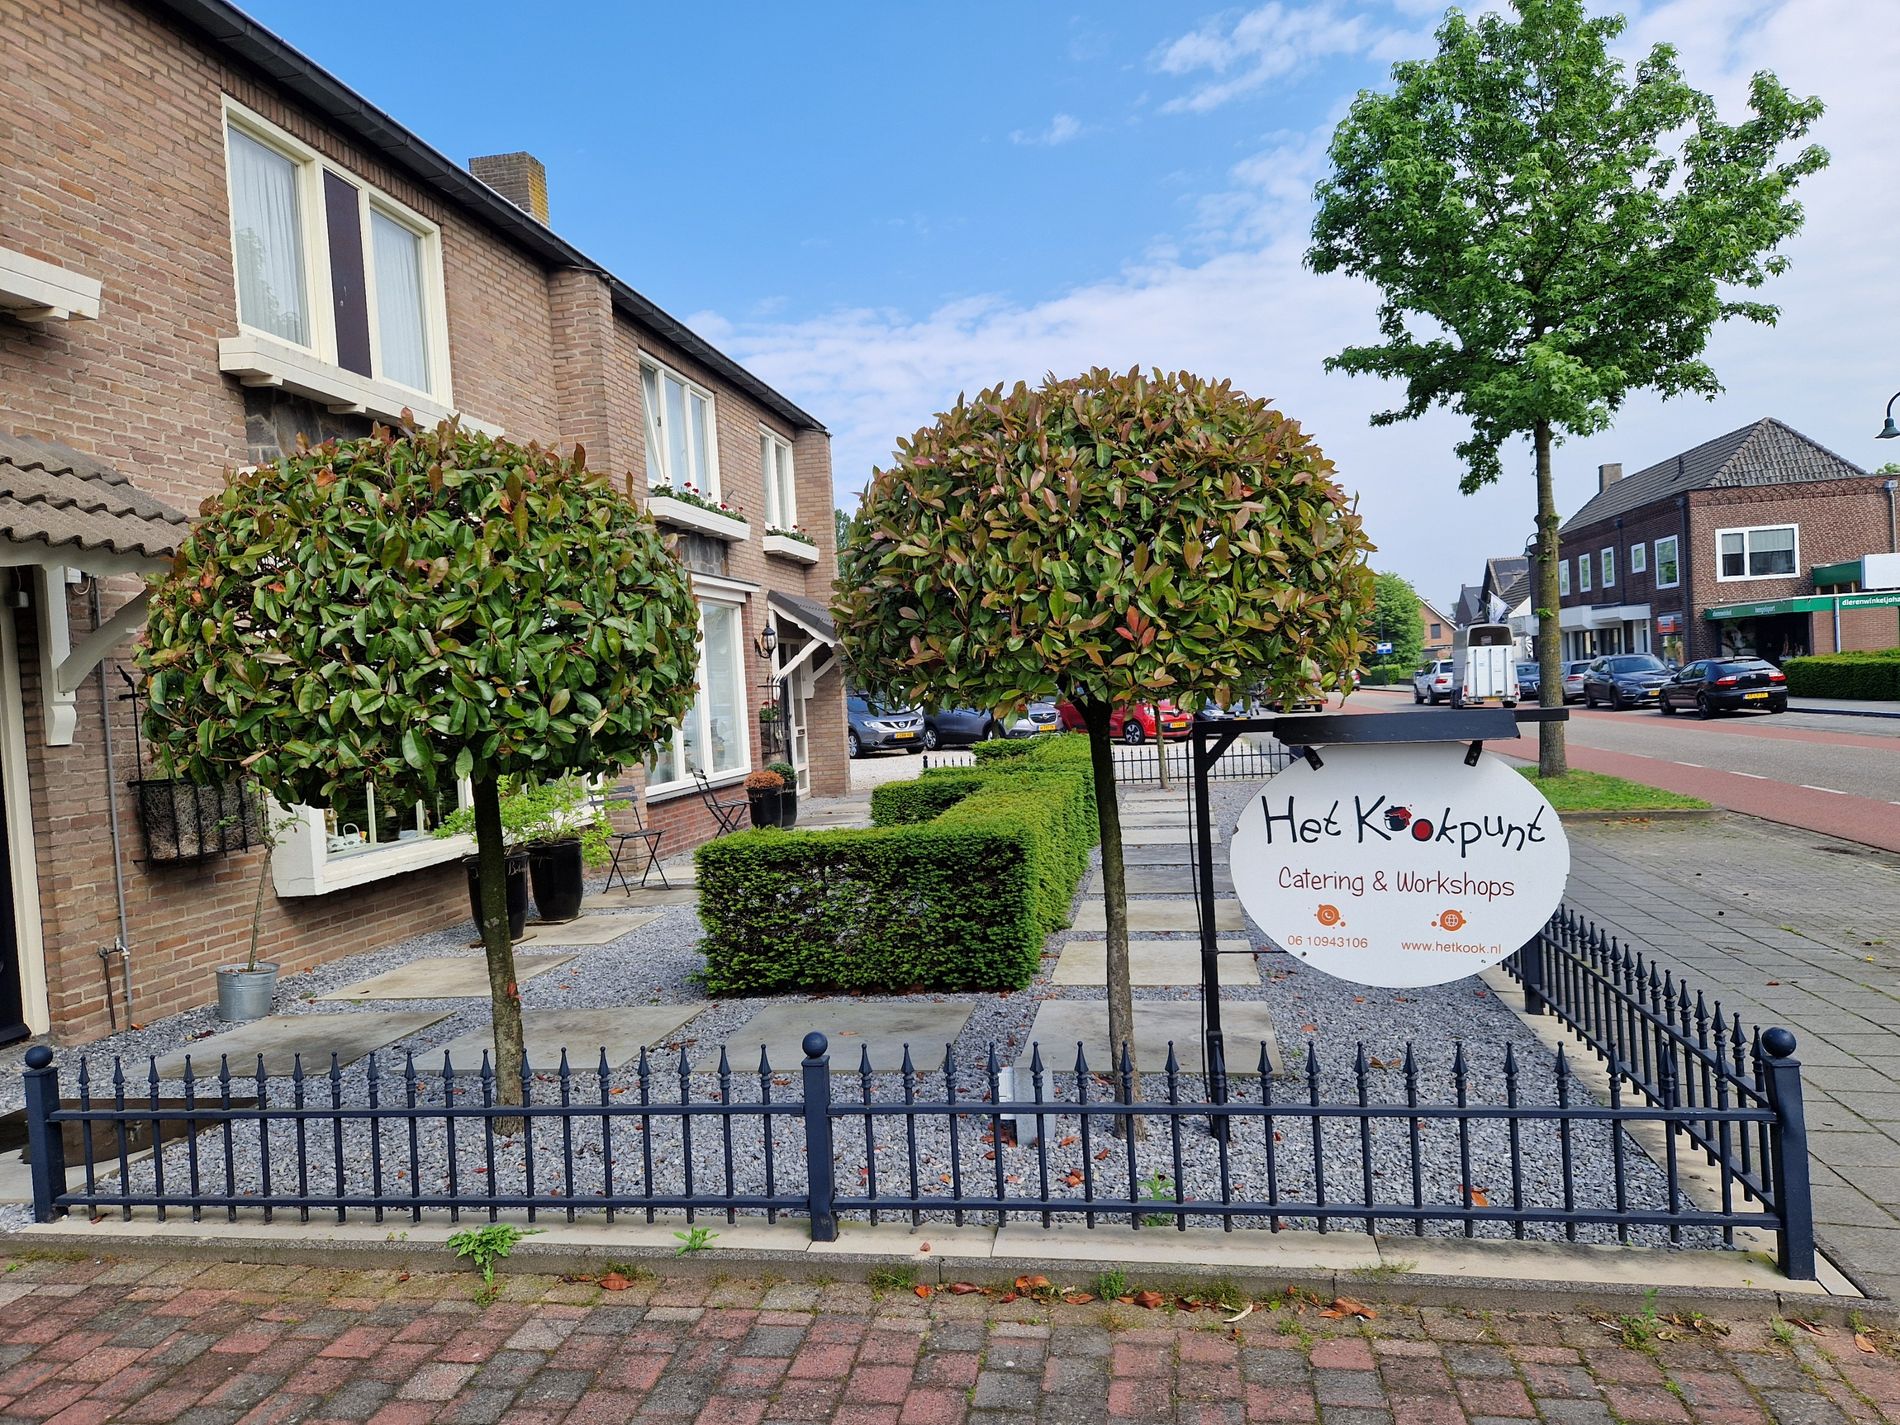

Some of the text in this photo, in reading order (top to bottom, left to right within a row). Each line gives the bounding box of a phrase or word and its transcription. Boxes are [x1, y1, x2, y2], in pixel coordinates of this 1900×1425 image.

[1261, 795, 1341, 844] Het
[1278, 866, 1515, 902] Catering & Workshops
[1287, 935, 1368, 948] 06 10943106
[1401, 941, 1501, 954] www.hetkook.nl
